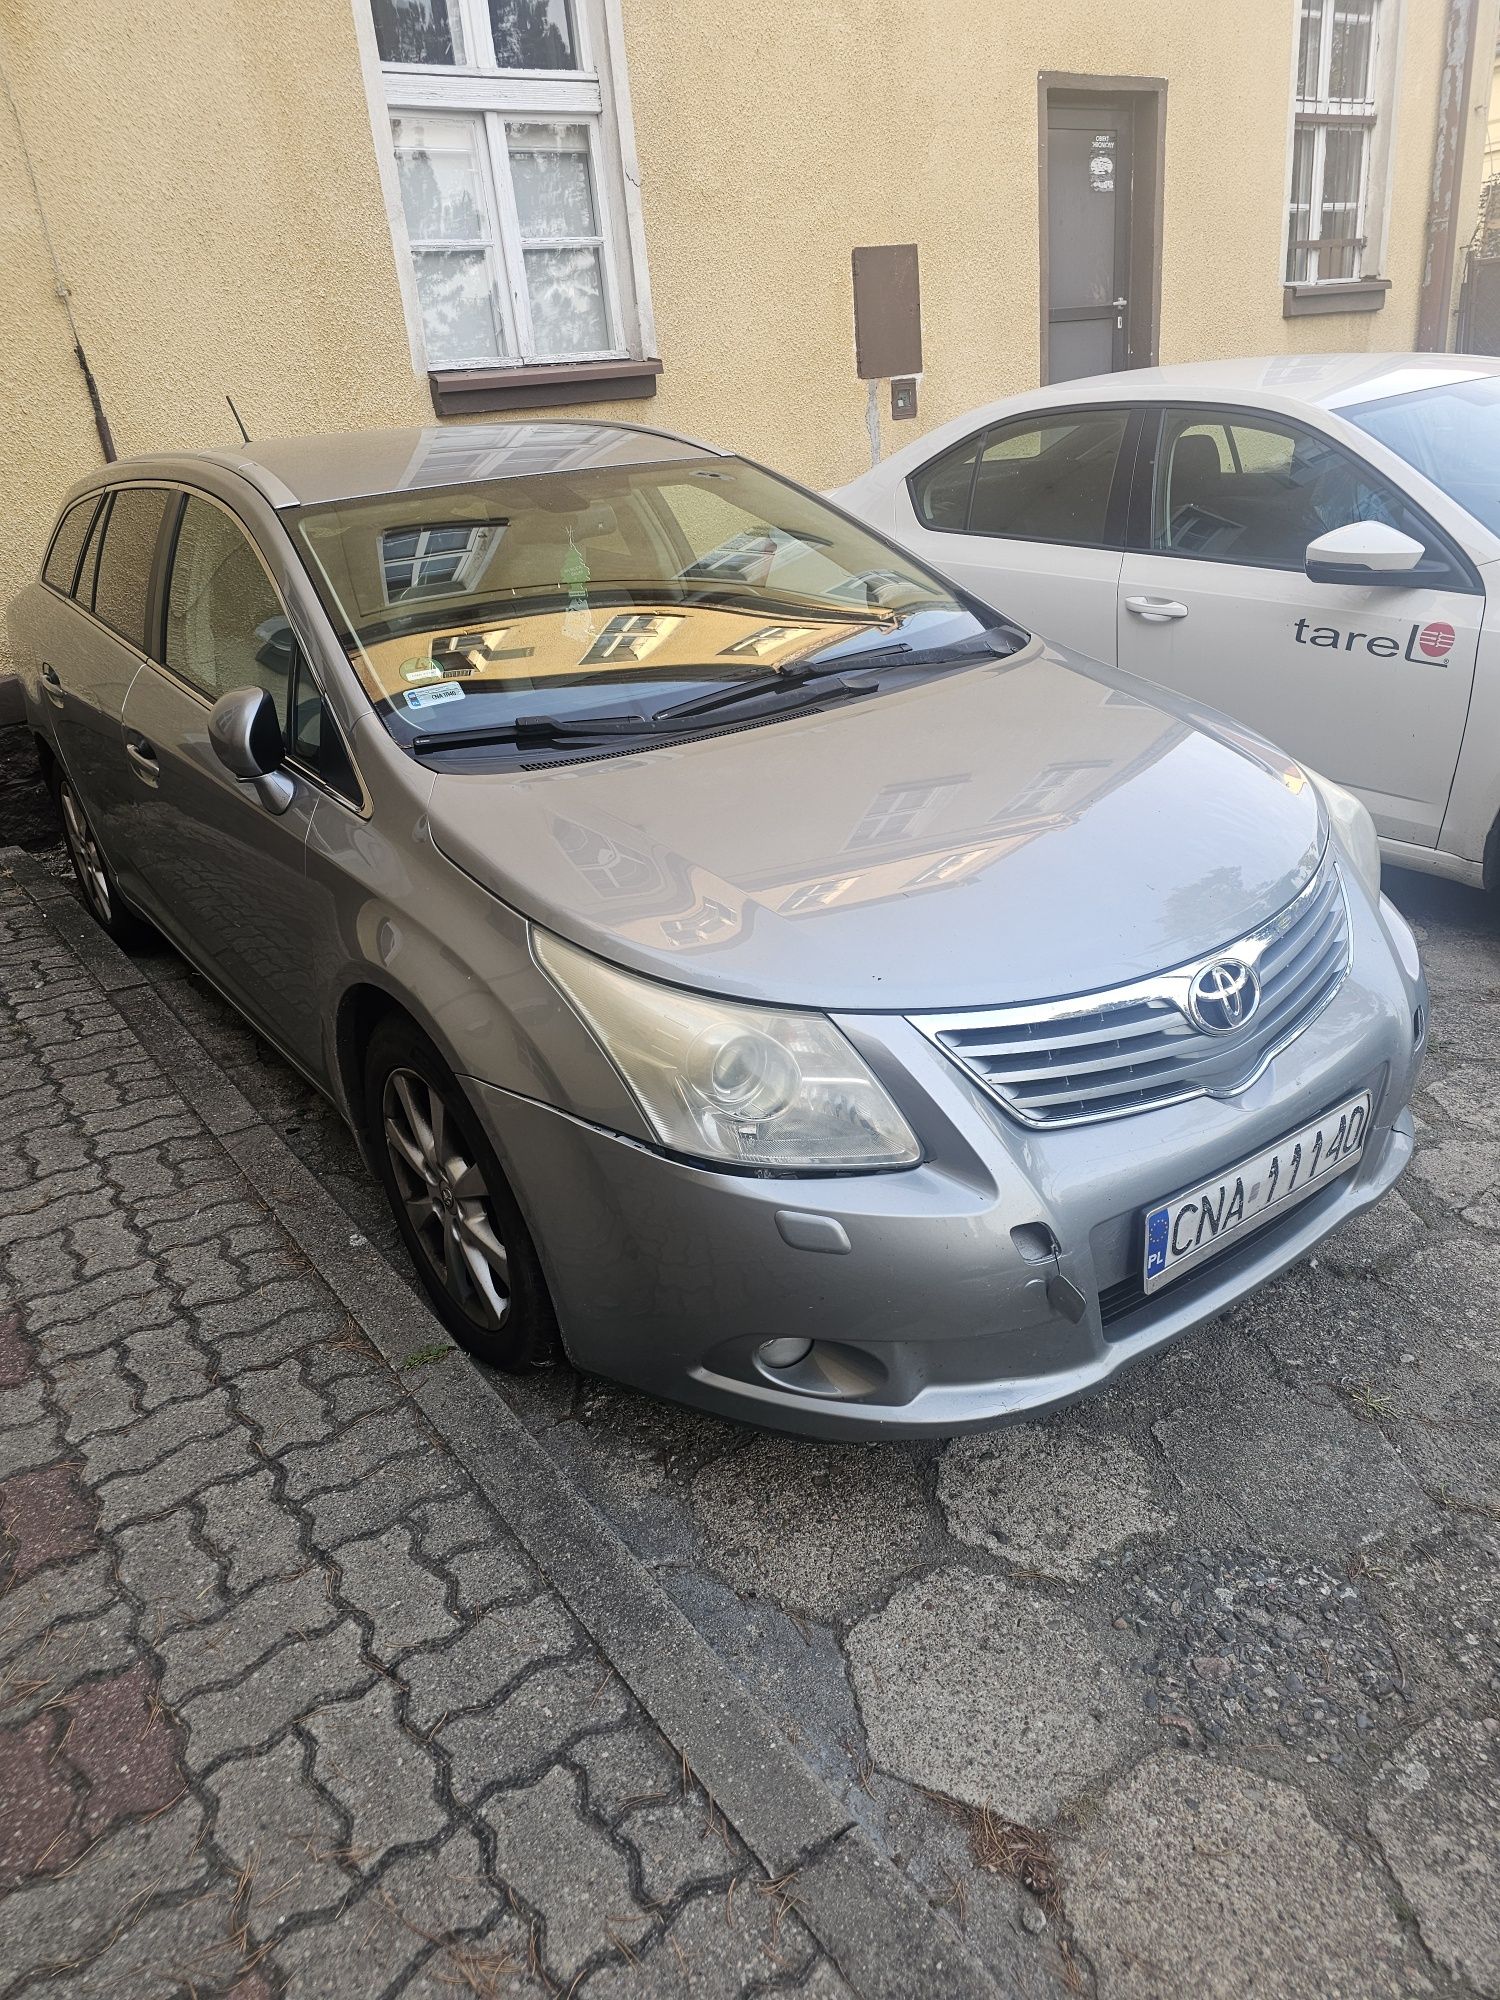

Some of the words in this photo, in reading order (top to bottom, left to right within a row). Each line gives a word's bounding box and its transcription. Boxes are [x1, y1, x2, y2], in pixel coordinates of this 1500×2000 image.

[1171, 1176, 1244, 1256] CNA
[1266, 1105, 1365, 1204] 11140
[1147, 1252, 1164, 1269] PL
